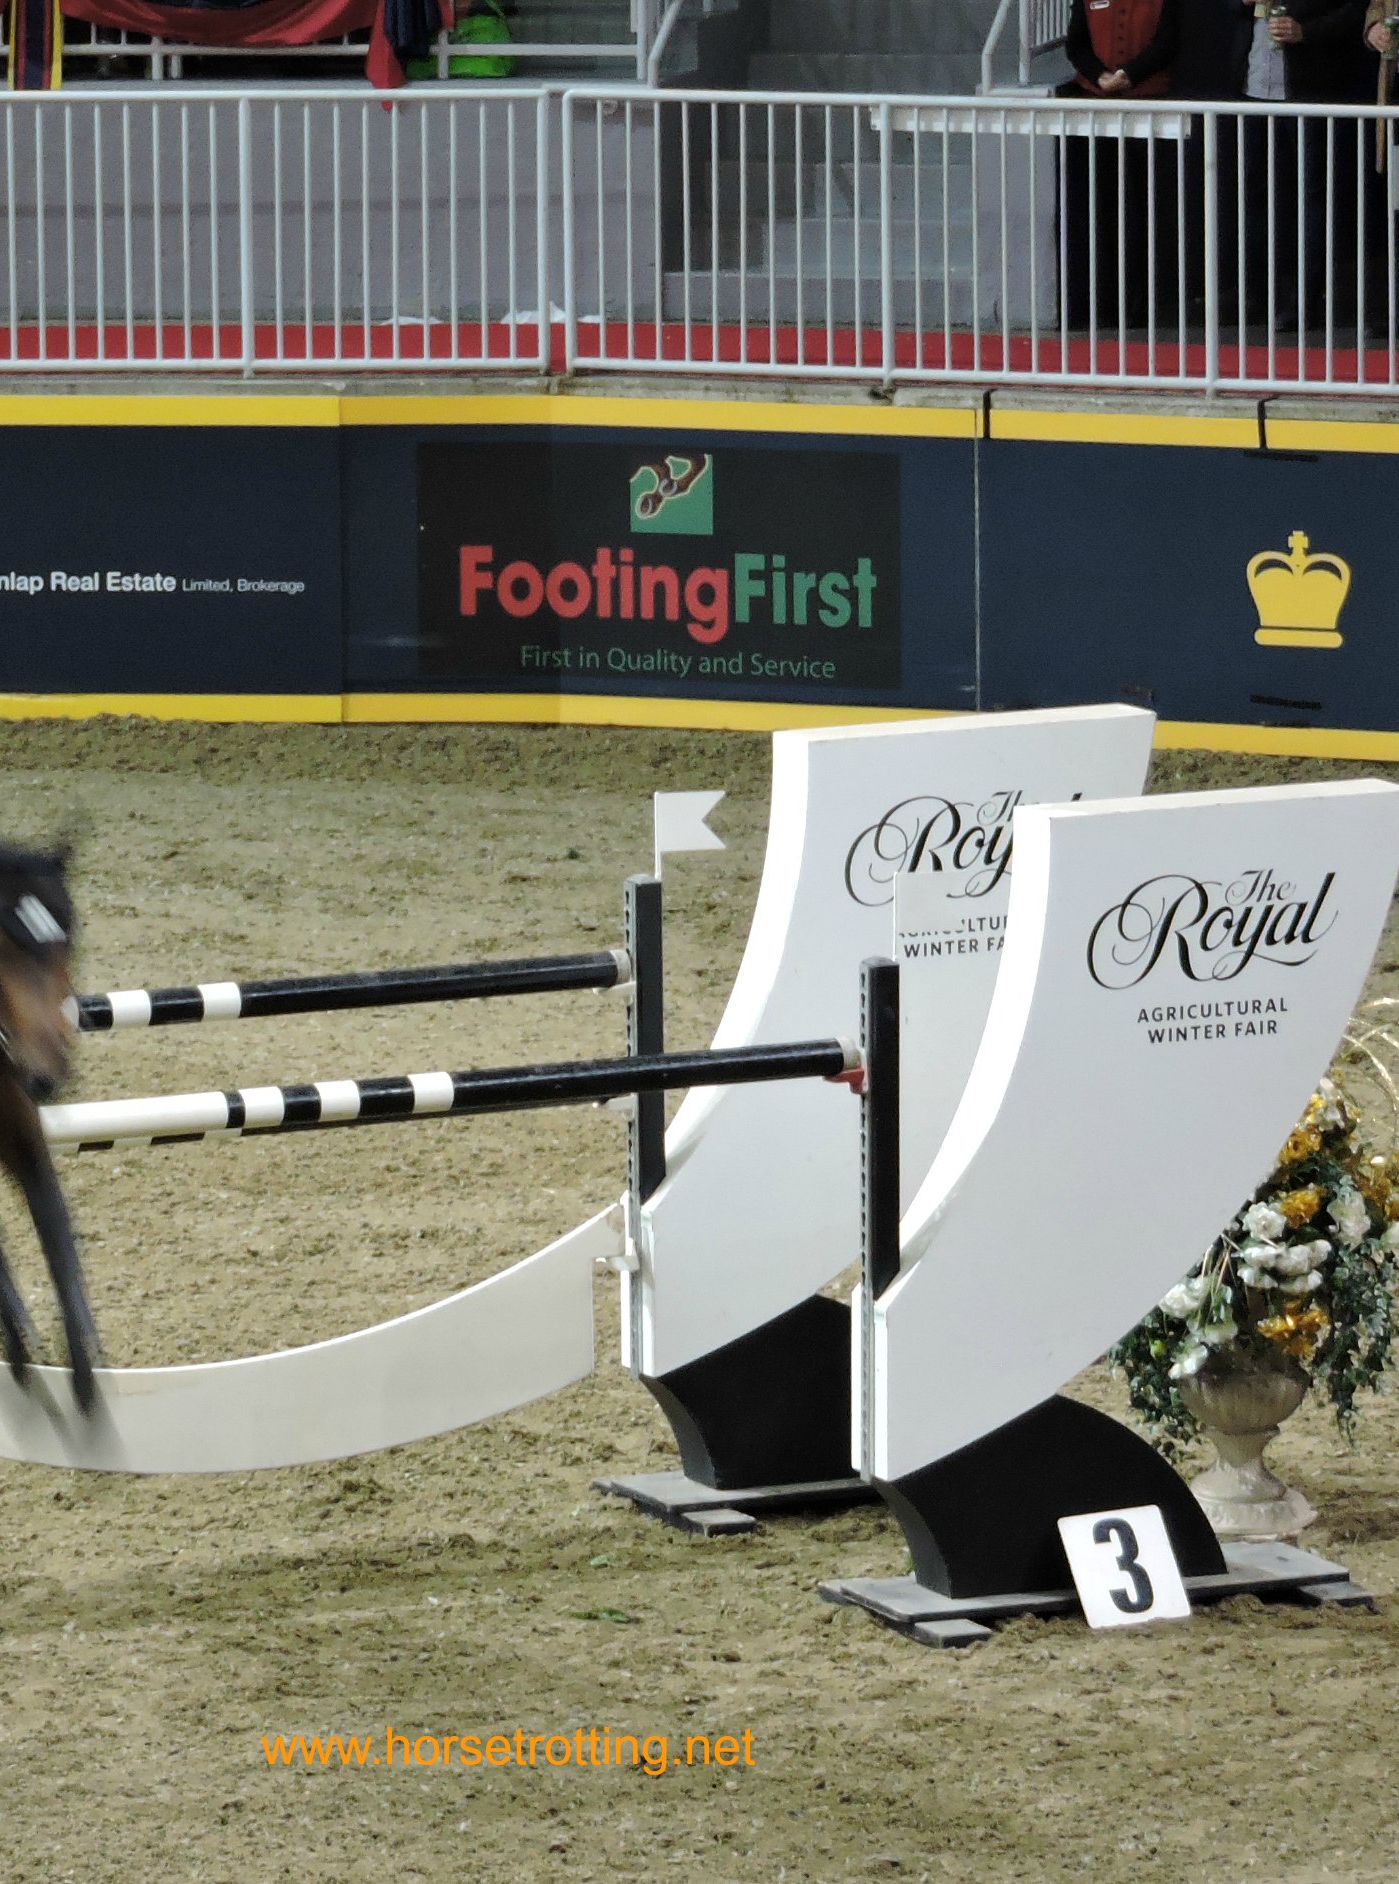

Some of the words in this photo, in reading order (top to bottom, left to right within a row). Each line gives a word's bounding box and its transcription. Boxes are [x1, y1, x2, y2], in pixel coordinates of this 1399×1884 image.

[51, 571, 100, 592] Real
[106, 571, 177, 592] Estate
[182, 578, 234, 593] Limited,
[237, 578, 305, 594] Brokerage
[459, 544, 877, 644] FootingFirst
[521, 645, 571, 668] First
[579, 648, 600, 668] in
[607, 648, 692, 675] Quality
[698, 652, 743, 675] and
[751, 652, 837, 679] Service
[845, 795, 1014, 906] Roy
[1225, 869, 1296, 905] The
[904, 939, 979, 958] WINTER
[1087, 872, 1338, 990] Royal
[1137, 997, 1288, 1023] AGRICULTURAL
[1148, 1024, 1226, 1044] WINTER
[1234, 1019, 1278, 1037] FAIR
[1093, 1518, 1154, 1613] 3
